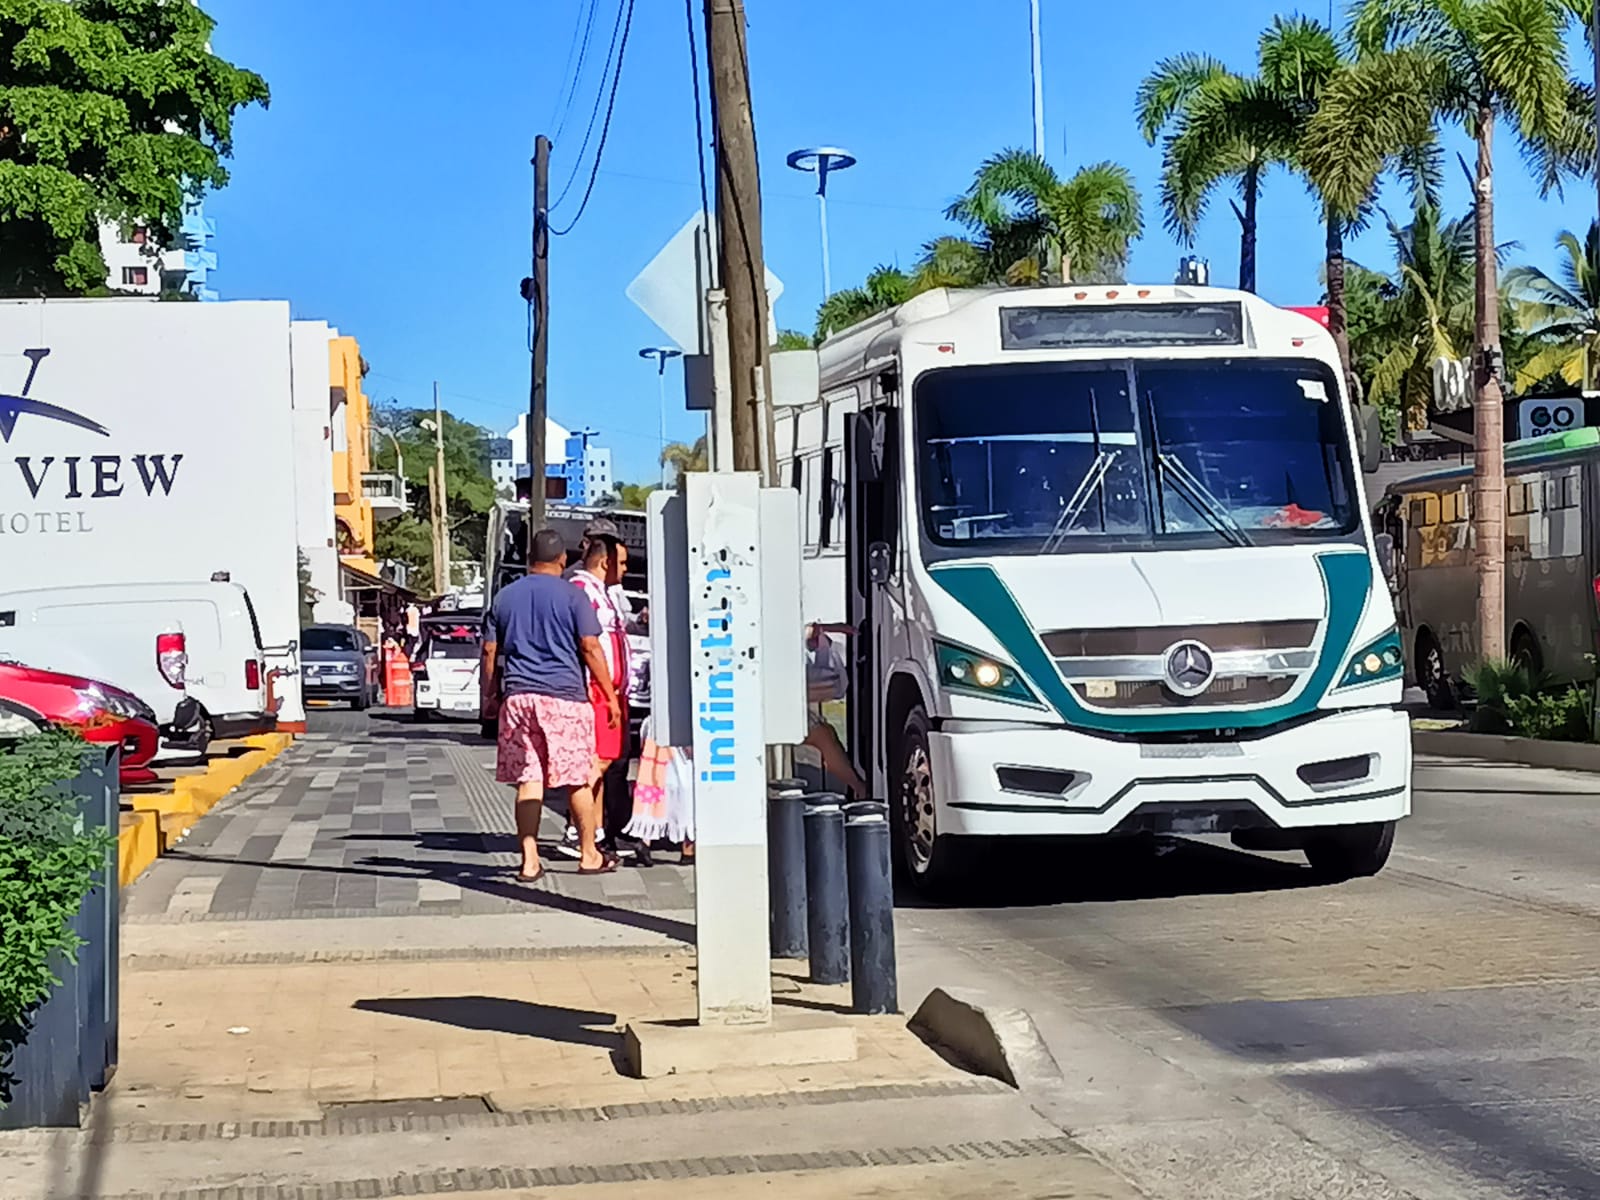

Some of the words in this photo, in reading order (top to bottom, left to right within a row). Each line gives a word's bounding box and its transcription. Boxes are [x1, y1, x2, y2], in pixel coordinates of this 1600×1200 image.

[1530, 406, 1574, 427] GO
[14, 454, 184, 499] VIEW
[700, 568, 736, 782] infint
